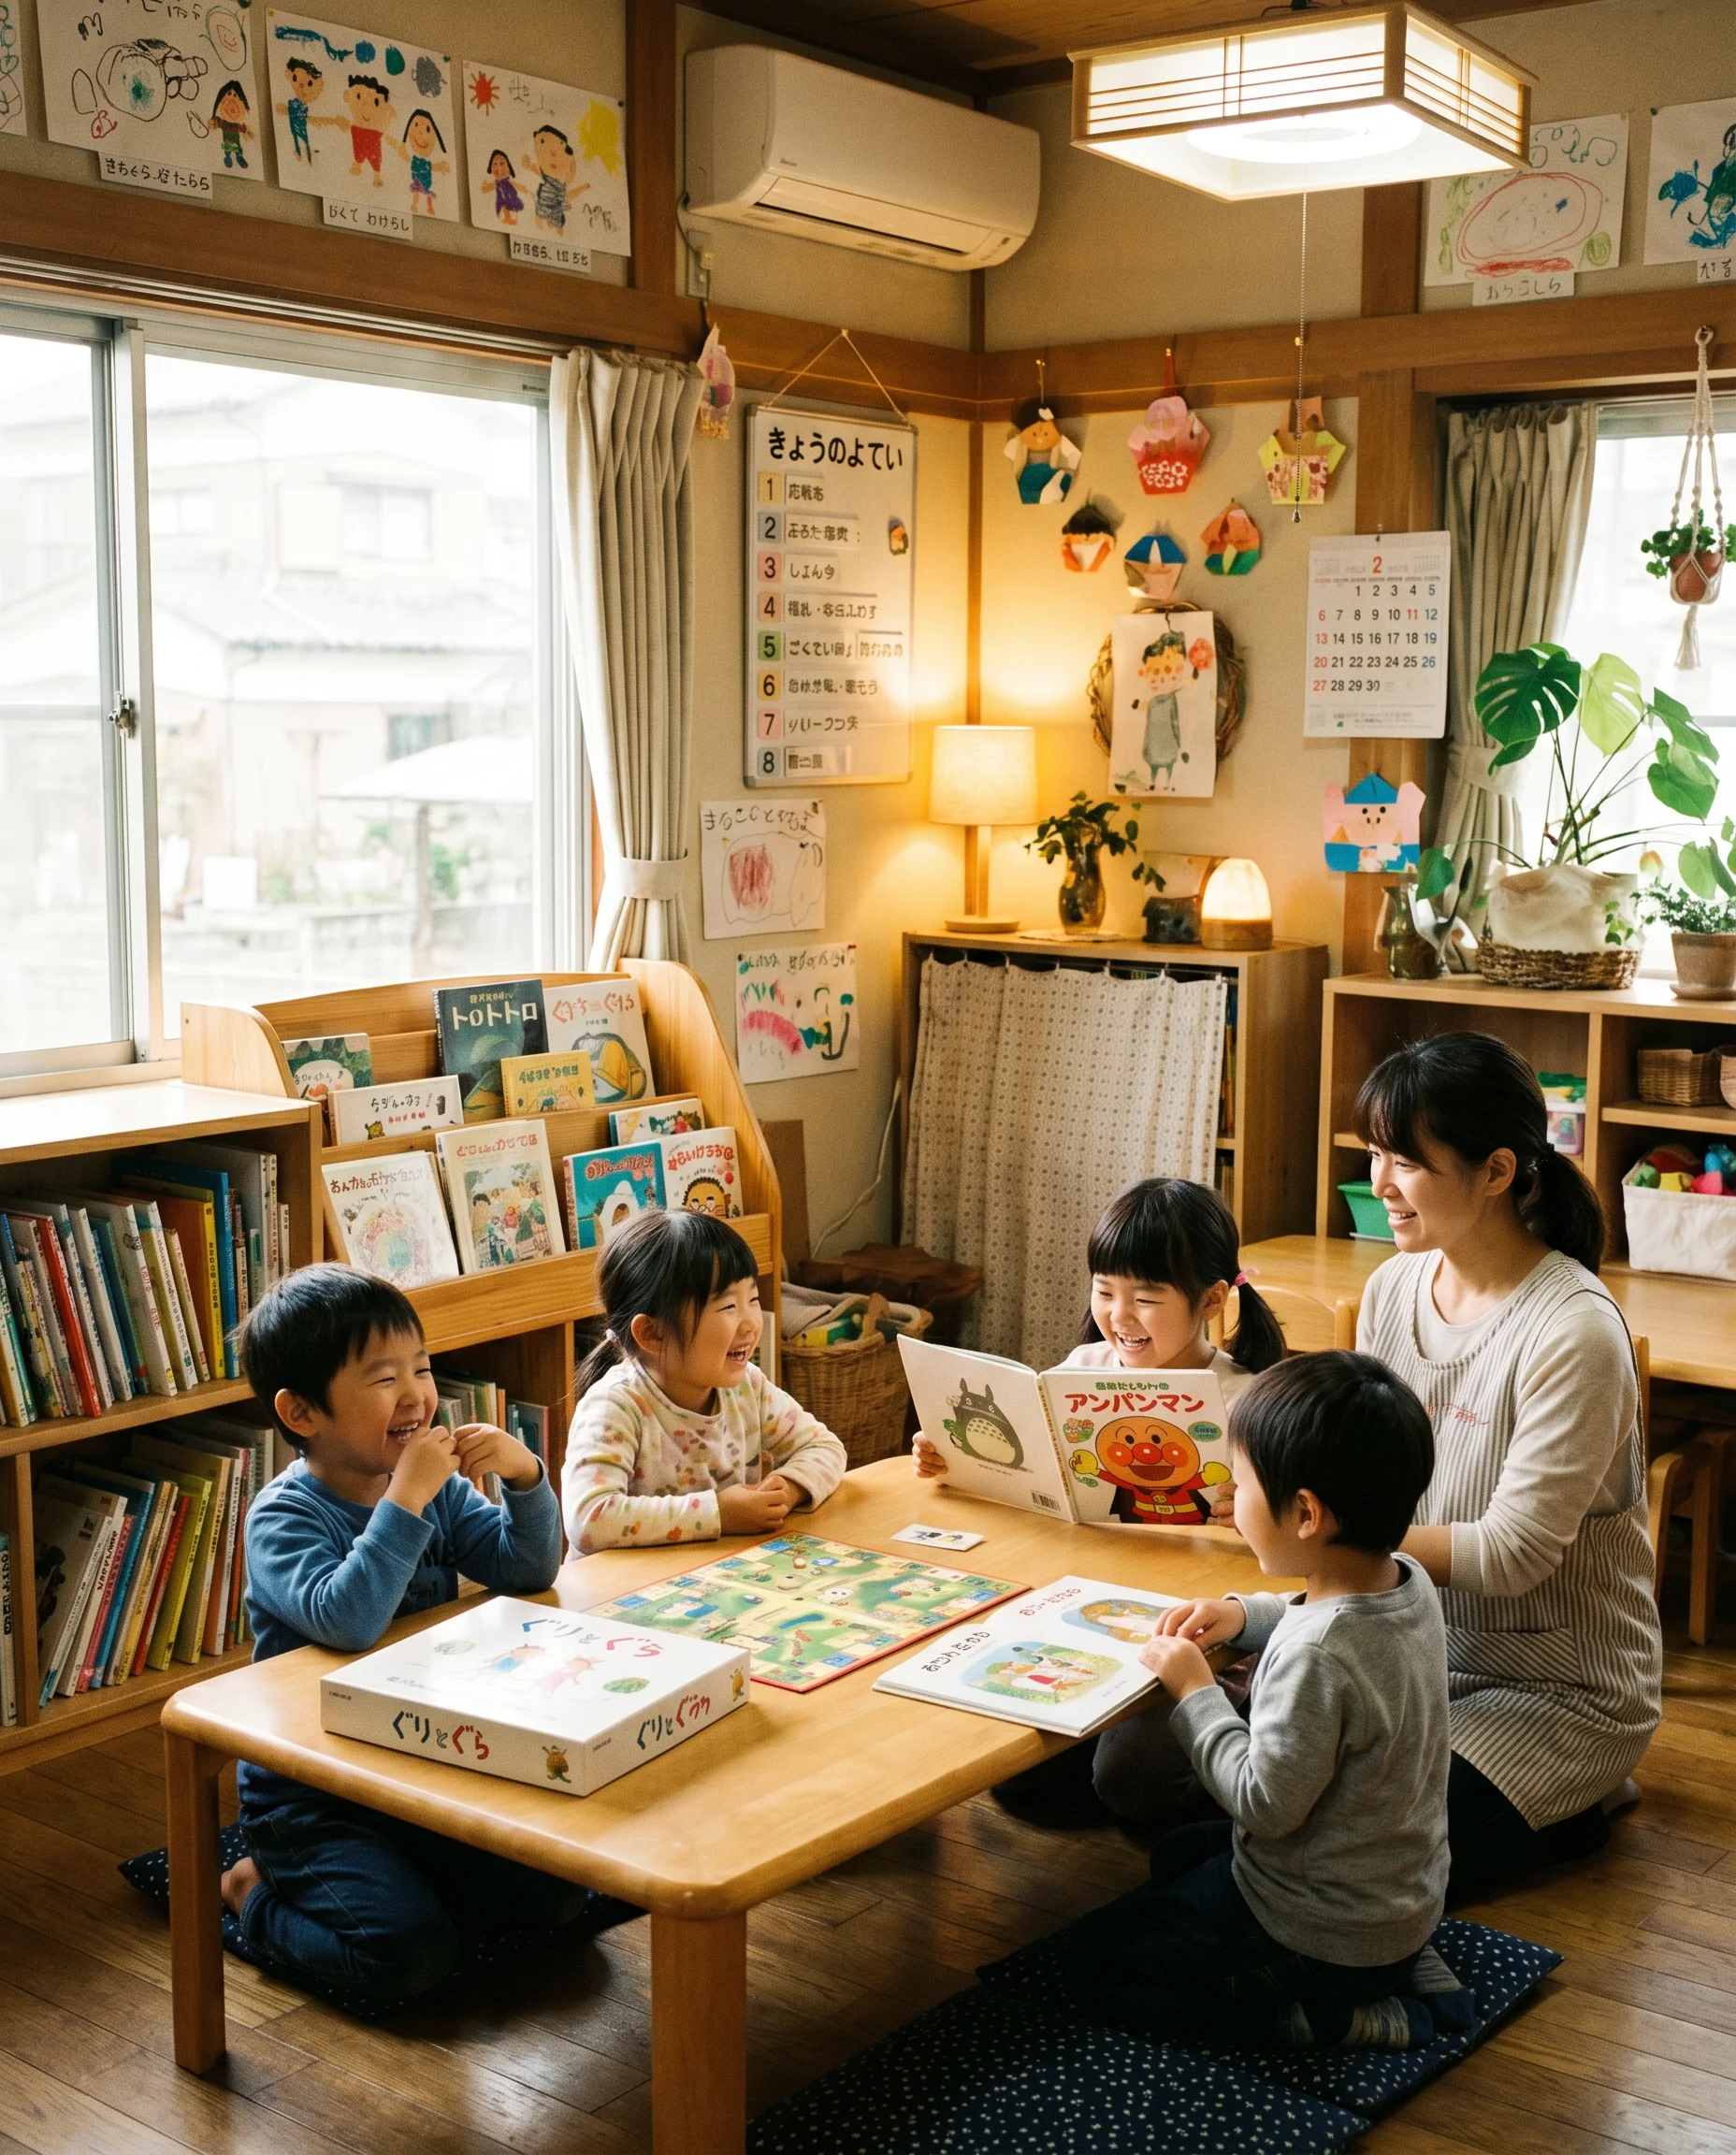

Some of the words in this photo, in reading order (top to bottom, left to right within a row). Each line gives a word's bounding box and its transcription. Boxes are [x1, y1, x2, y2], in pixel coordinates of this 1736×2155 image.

[768, 427, 904, 470] きょうのよてい
[767, 477, 774, 500] 1
[764, 516, 776, 540] 2
[764, 557, 776, 579] 3
[1373, 557, 1382, 573] 2
[1356, 586, 1360, 596] 1
[1373, 585, 1380, 597] 2
[1391, 585, 1397, 596] 3
[1410, 585, 1416, 595] 4
[1428, 584, 1435, 596] 5
[763, 596, 775, 617] 4
[1319, 610, 1325, 621] 6
[1337, 610, 1343, 620] 7
[1354, 609, 1361, 620] 8
[1372, 609, 1379, 620] 9
[1389, 608, 1400, 620] 10
[1408, 609, 1417, 620] 11
[1425, 608, 1438, 620] 12
[763, 636, 775, 658] 5
[1316, 633, 1327, 644] 13
[1334, 633, 1344, 644] 14
[1352, 633, 1363, 644] 15
[1369, 633, 1382, 644] 16
[1388, 632, 1399, 644] 17
[1406, 632, 1418, 644] 18
[1425, 632, 1437, 644] 19
[1314, 657, 1327, 668] 20
[1332, 657, 1343, 668] 21
[1350, 657, 1363, 668] 22
[1367, 657, 1381, 668] 23
[1385, 657, 1398, 667] 24
[1404, 657, 1417, 668] 25
[1422, 657, 1436, 668] 26
[762, 674, 775, 696] 6
[1313, 680, 1326, 691] 27
[1331, 680, 1344, 691] 28
[1349, 680, 1362, 691] 29
[1367, 680, 1380, 691] 30
[763, 714, 775, 735] 7
[762, 751, 774, 774] 8
[1064, 1393, 1205, 1413] アンパンマン
[522, 1619, 663, 1657] ぐりとぐら
[393, 1711, 489, 1760] ぐりとぐら
